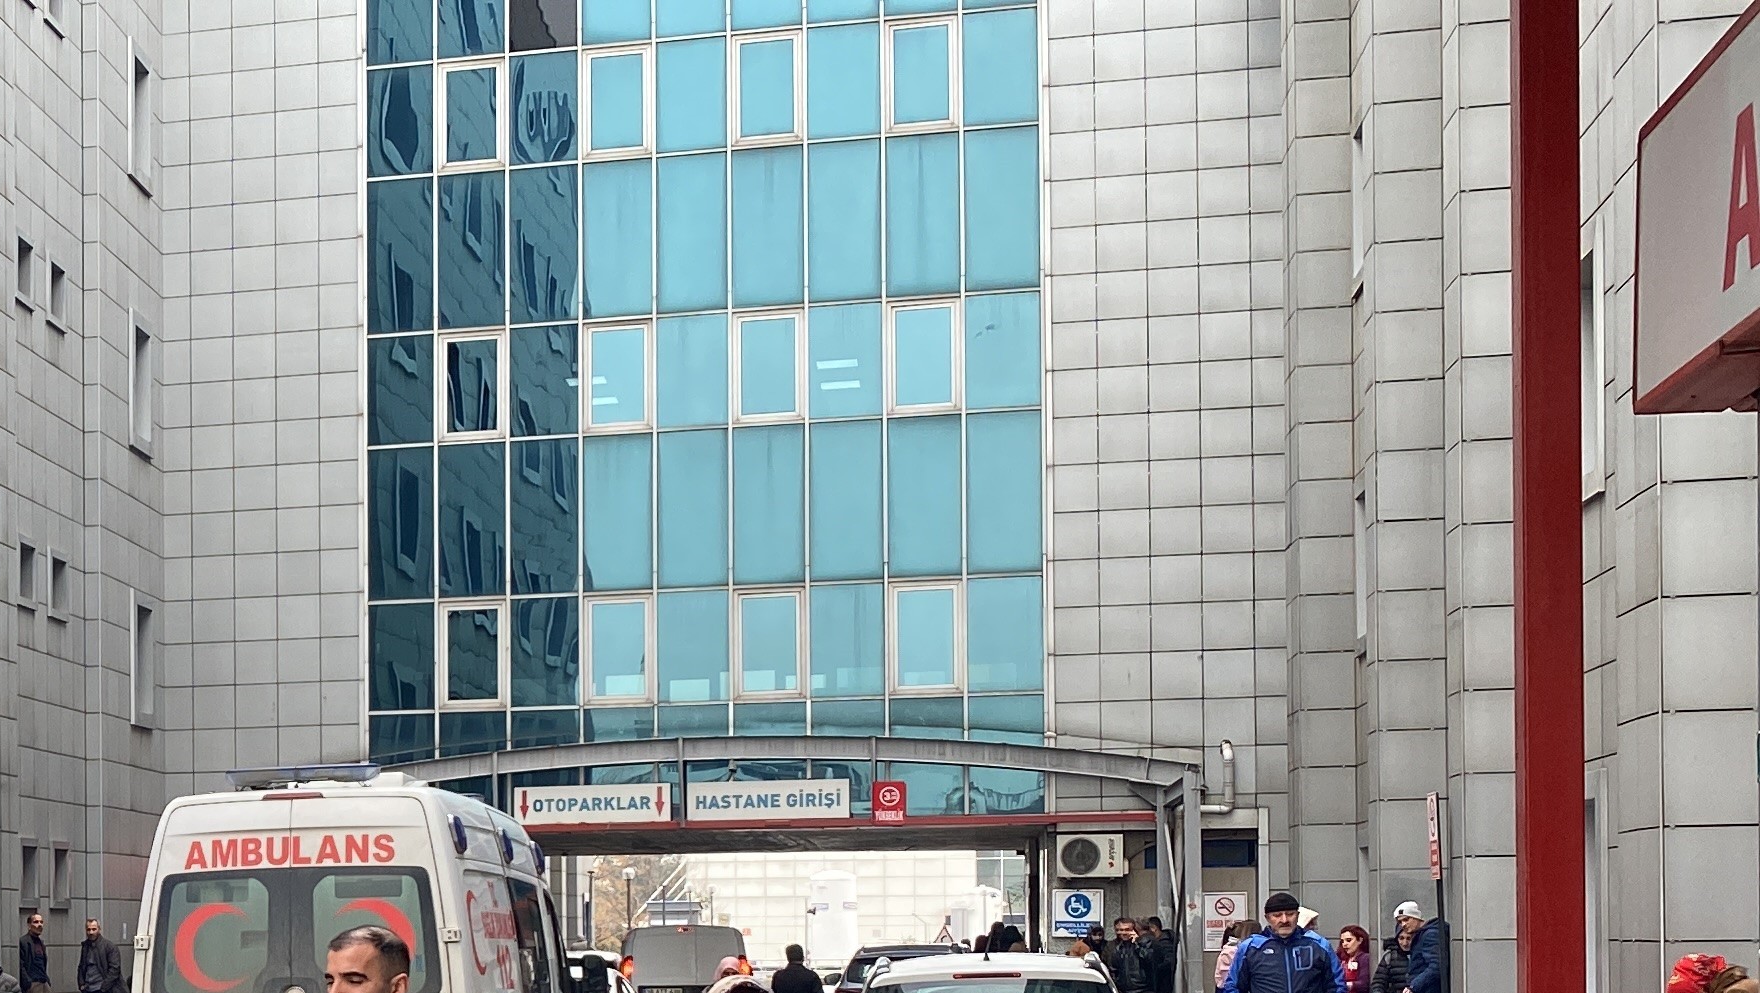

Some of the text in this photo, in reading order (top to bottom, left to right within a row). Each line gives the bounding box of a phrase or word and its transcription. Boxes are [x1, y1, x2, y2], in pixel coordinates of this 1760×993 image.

[533, 795, 651, 812] OTOPARKLAR
[695, 788, 842, 809] HASTANE GİRİŞİ
[184, 834, 395, 870] AMBULANS
